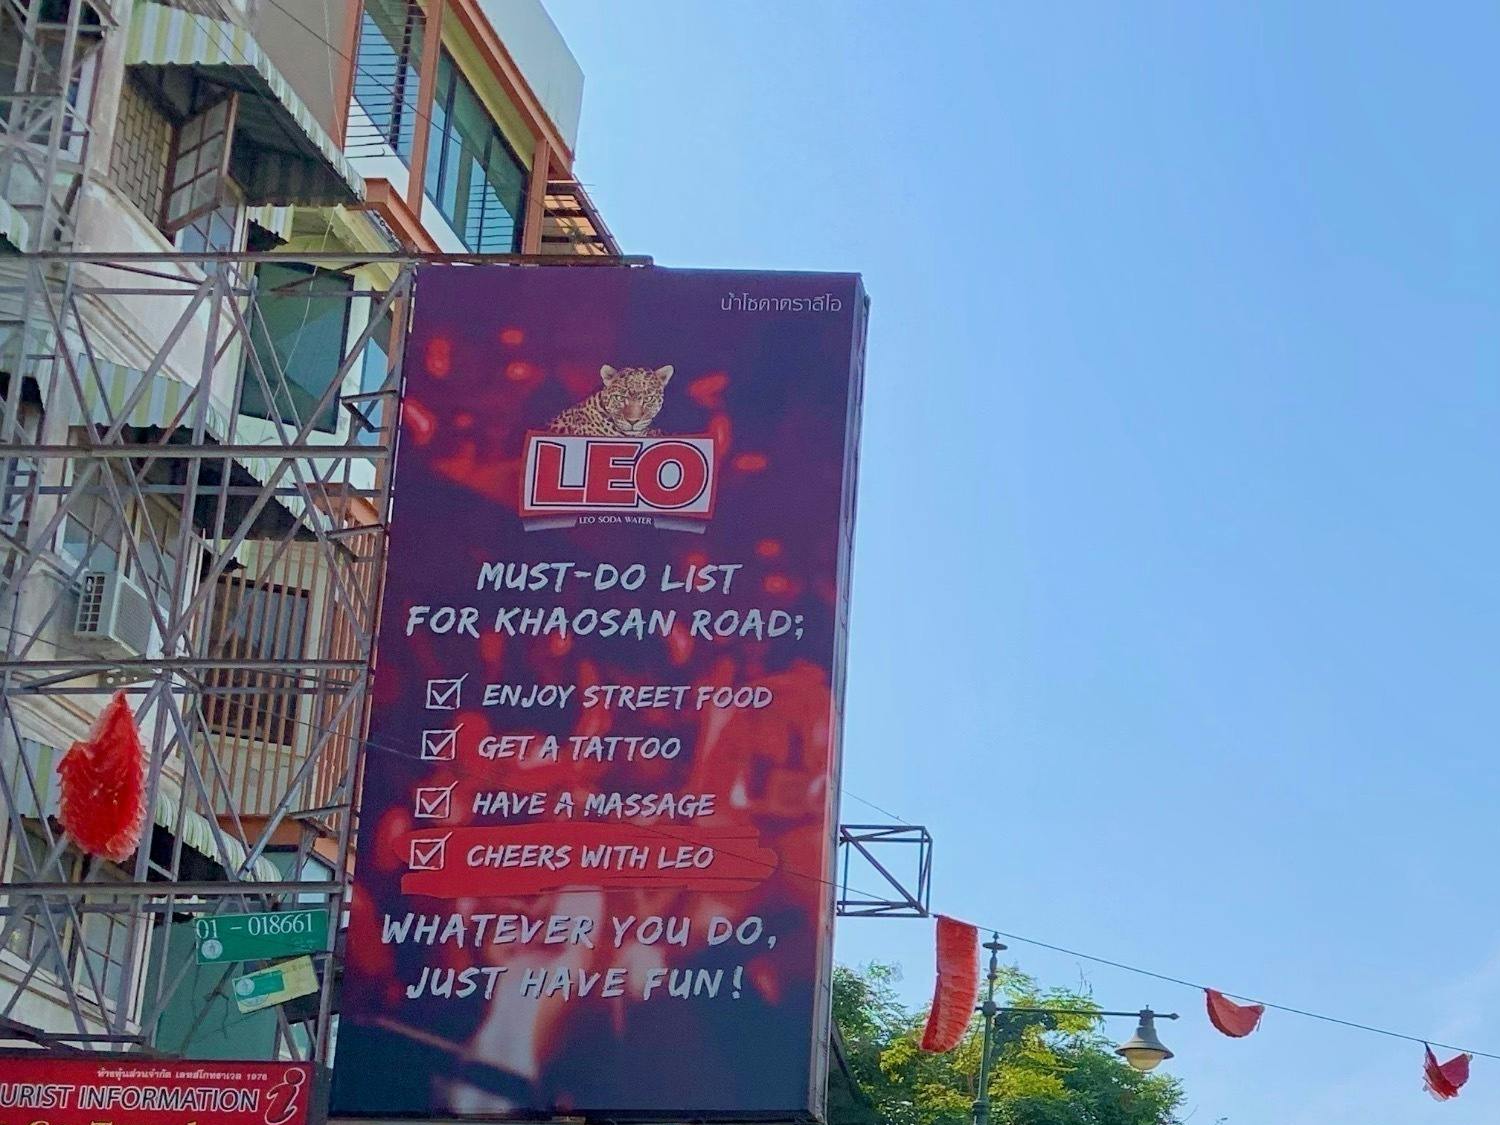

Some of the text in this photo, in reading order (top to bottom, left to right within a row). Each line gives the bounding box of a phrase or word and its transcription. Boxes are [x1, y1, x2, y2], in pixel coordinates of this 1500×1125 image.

[720, 291, 842, 312] น้ำโซดาตราลีโอ
[532, 441, 711, 510] LEO
[578, 515, 652, 526] LEO SODA WATER
[477, 562, 743, 594] MUST-DO LIST
[406, 606, 480, 637] FOR
[495, 608, 675, 639] KHAOSAN
[482, 683, 773, 709] ENJOY STREET FOOD
[478, 735, 681, 761] GET A TATTOO
[473, 792, 716, 818] HAVE A MASSAGE
[467, 844, 715, 870] CHEERS WITH LEO
[195, 918, 219, 938] 01
[249, 913, 314, 936] 018661
[382, 912, 778, 950] WHATEVER YOU DO,
[406, 966, 744, 1000] JUST HAVE FUN!
[78, 1085, 260, 1113] INFORMATION
